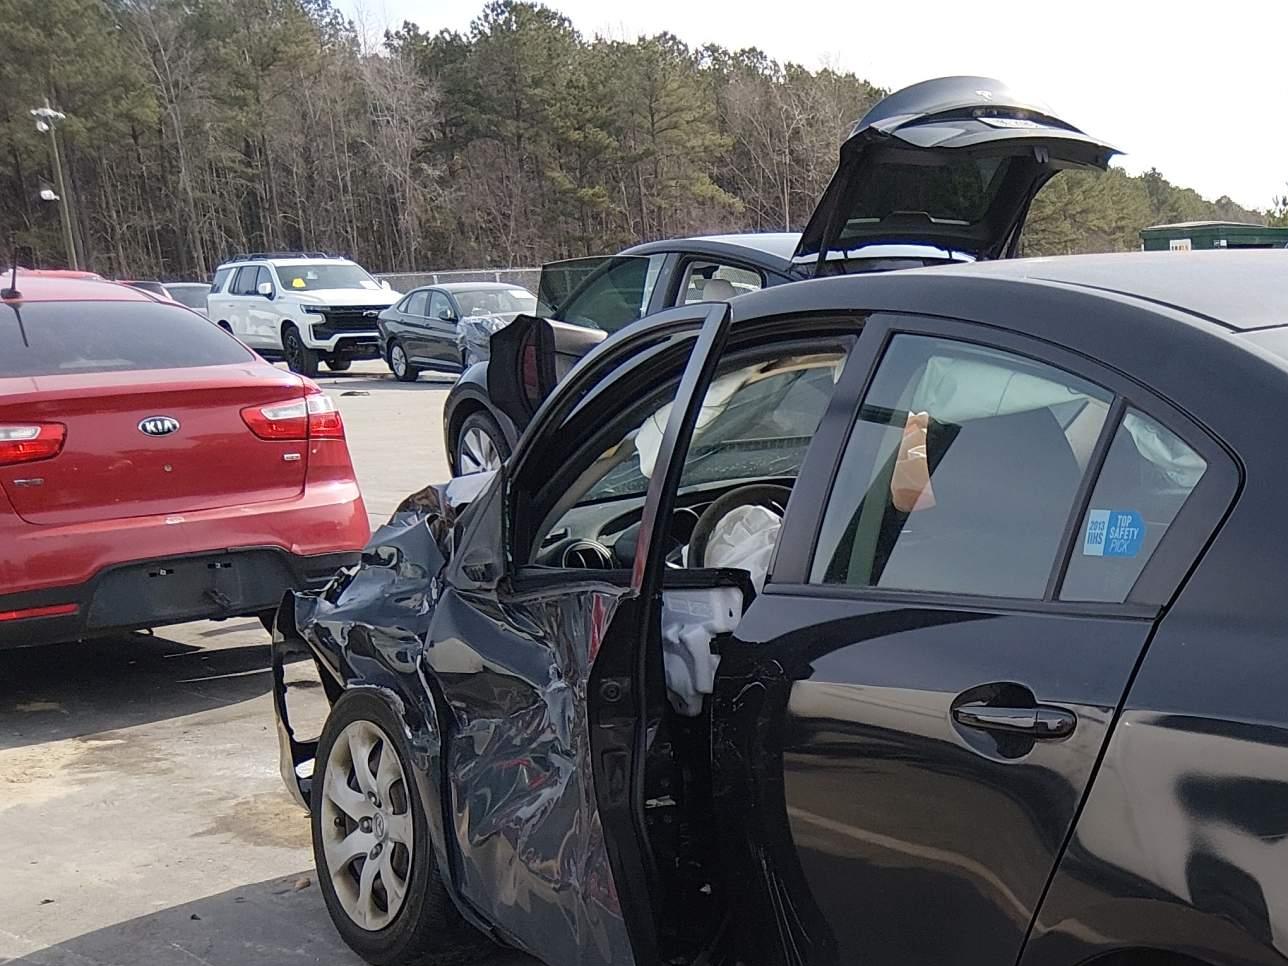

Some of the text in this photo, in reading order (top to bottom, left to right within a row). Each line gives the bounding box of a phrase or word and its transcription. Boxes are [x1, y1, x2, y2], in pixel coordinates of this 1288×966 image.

[145, 420, 175, 433] KIA
[1089, 521, 1106, 532] 2013
[1117, 515, 1133, 528] TOP
[1087, 531, 1104, 545] IIHS
[1109, 527, 1140, 540] SAFETY
[1109, 539, 1131, 553] PICK
